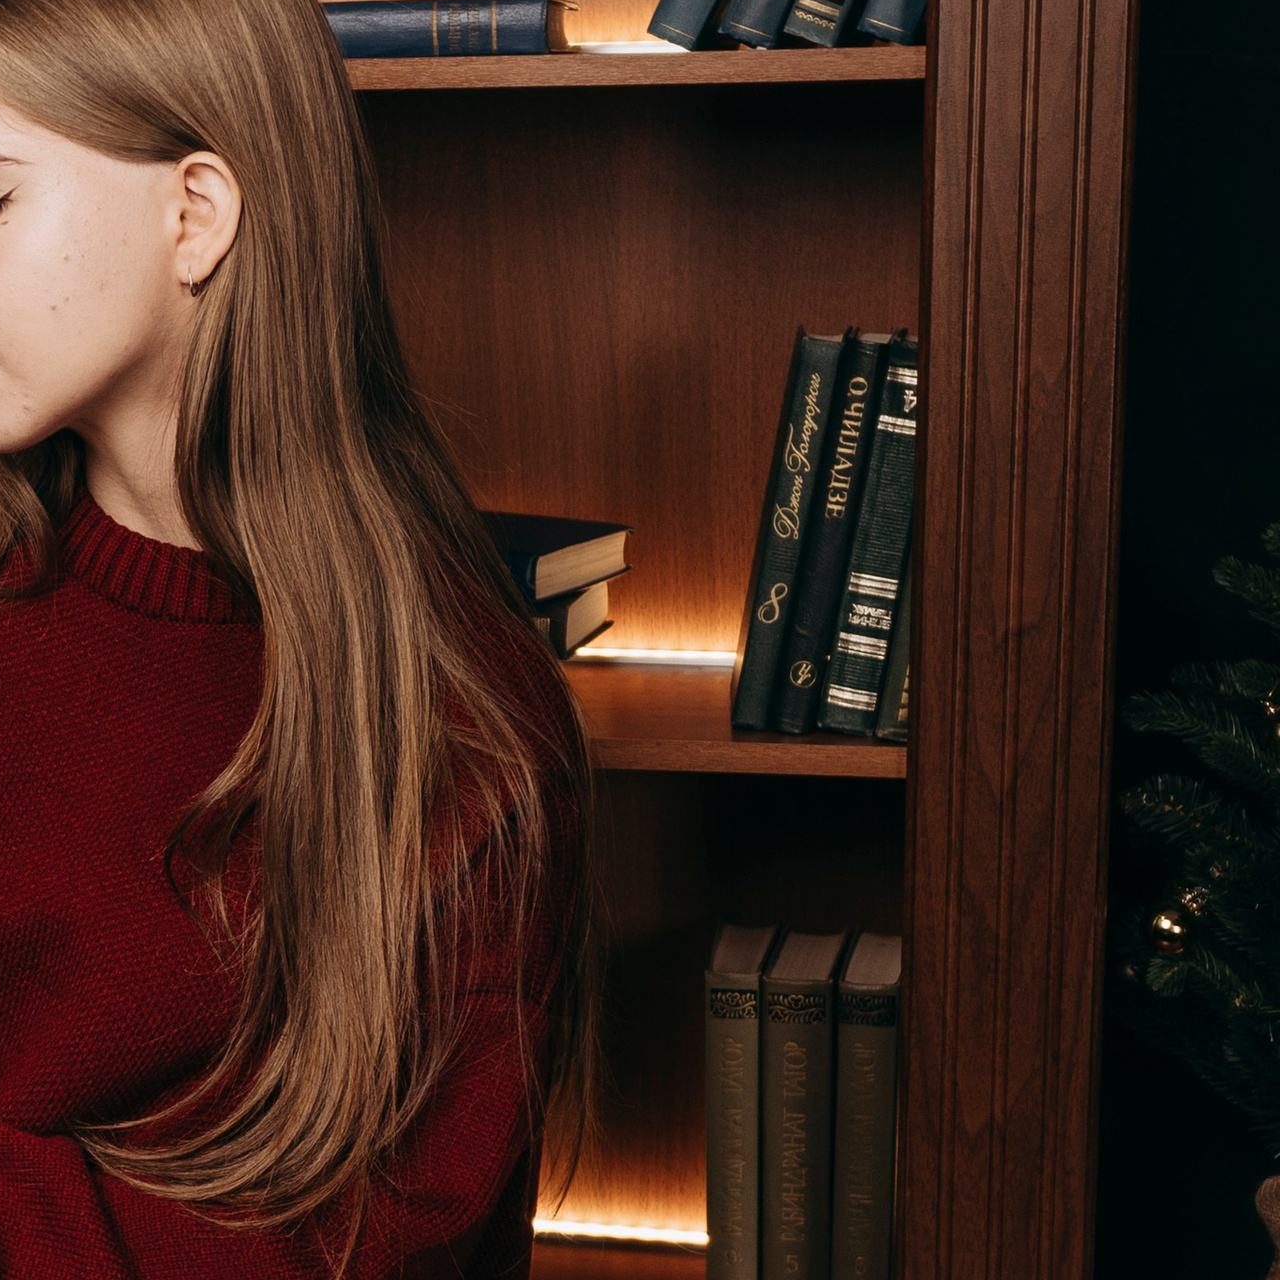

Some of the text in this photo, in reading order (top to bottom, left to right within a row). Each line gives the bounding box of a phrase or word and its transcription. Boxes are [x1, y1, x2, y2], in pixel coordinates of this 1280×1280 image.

[773, 372, 821, 540] Джон Голсуорси
[825, 402, 865, 519] ЧИЛАДЗЕ
[757, 582, 788, 624] 8
[781, 1041, 807, 1241] РАБИНДРАНАТ ТАГОР
[786, 1254, 799, 1272] 5
